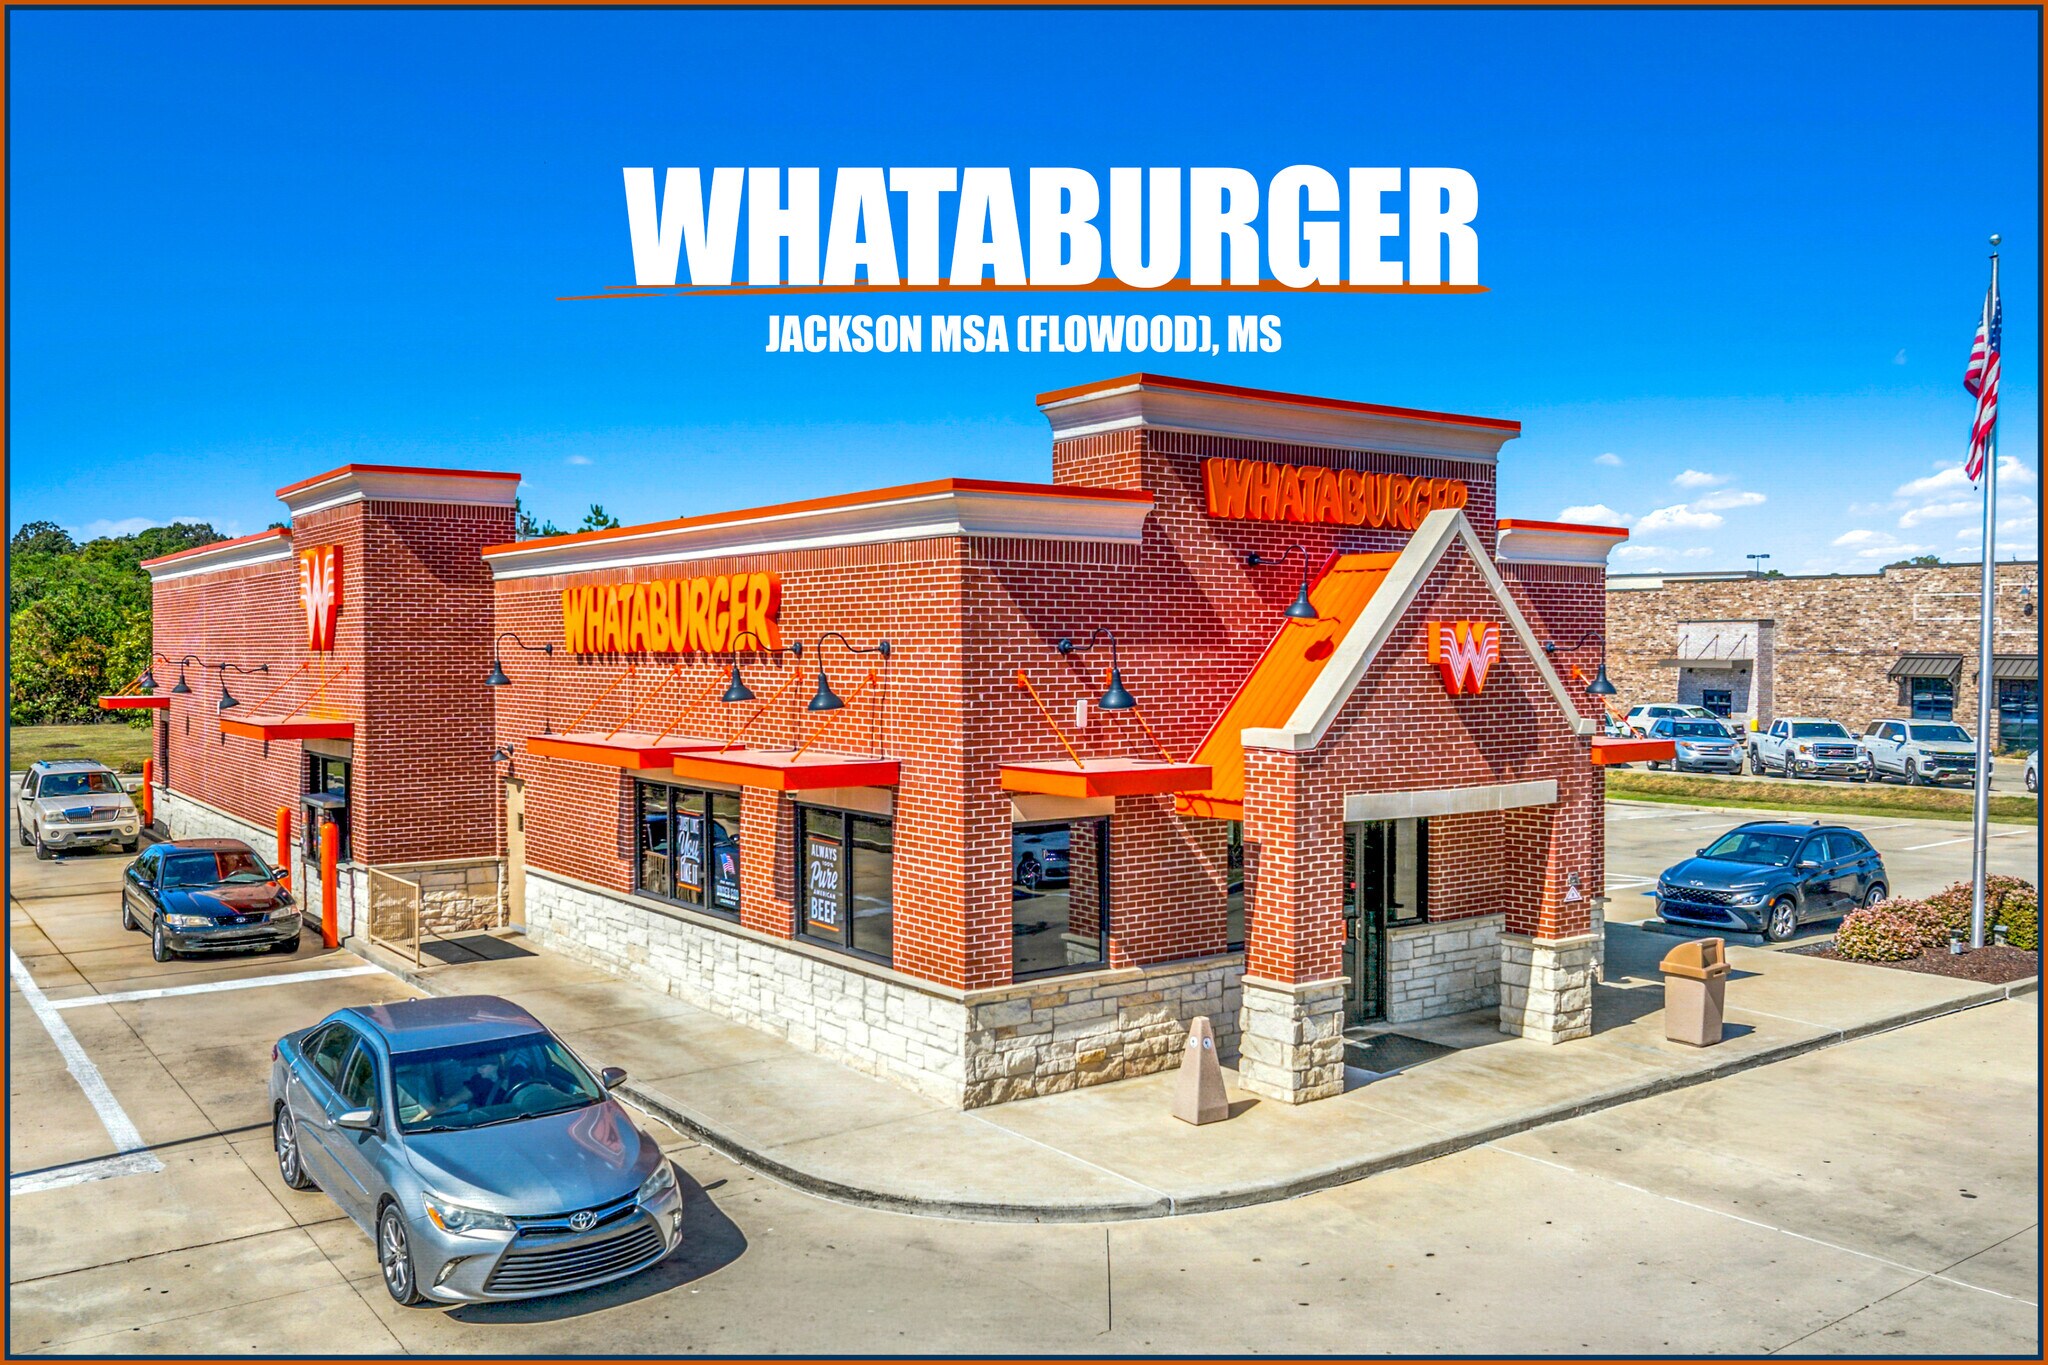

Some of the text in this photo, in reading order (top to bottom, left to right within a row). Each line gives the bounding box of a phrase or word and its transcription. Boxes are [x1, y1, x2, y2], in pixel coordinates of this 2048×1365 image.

[300, 546, 340, 651] W
[562, 572, 776, 653] WHATABURGER
[1434, 621, 1499, 694] W
[810, 860, 838, 890] Pure
[811, 844, 837, 861] ALWAYS
[811, 896, 837, 924] BEEF
